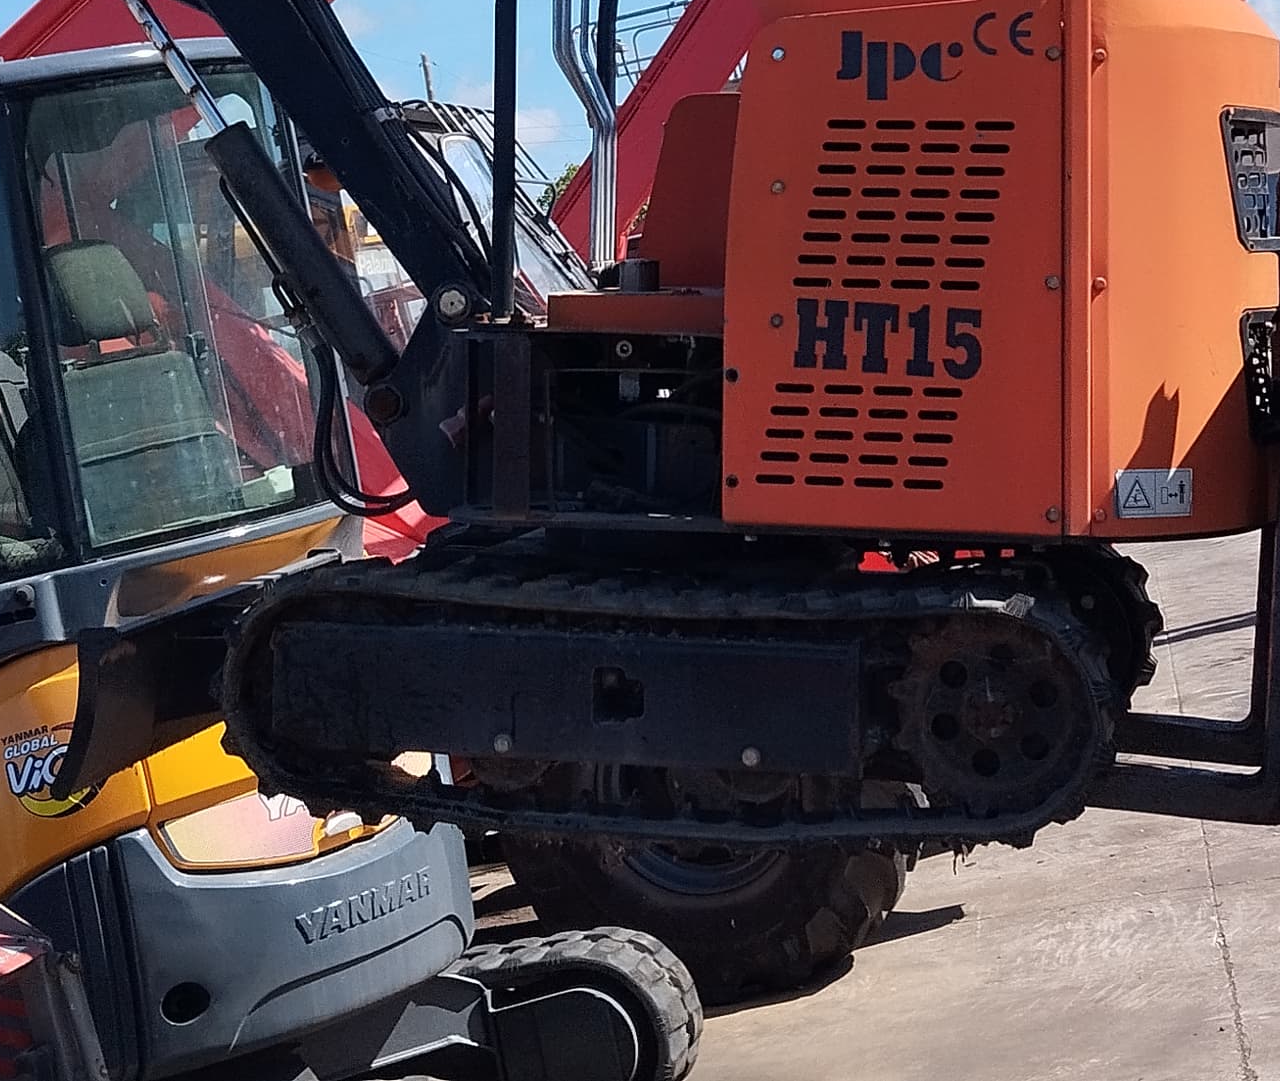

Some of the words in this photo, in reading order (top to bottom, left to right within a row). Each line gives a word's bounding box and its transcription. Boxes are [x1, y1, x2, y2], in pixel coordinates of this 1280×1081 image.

[793, 298, 982, 380] HT15
[0, 724, 49, 746] YANMAR
[4, 734, 59, 760] GLOBAL
[294, 865, 431, 945] YANMAR
